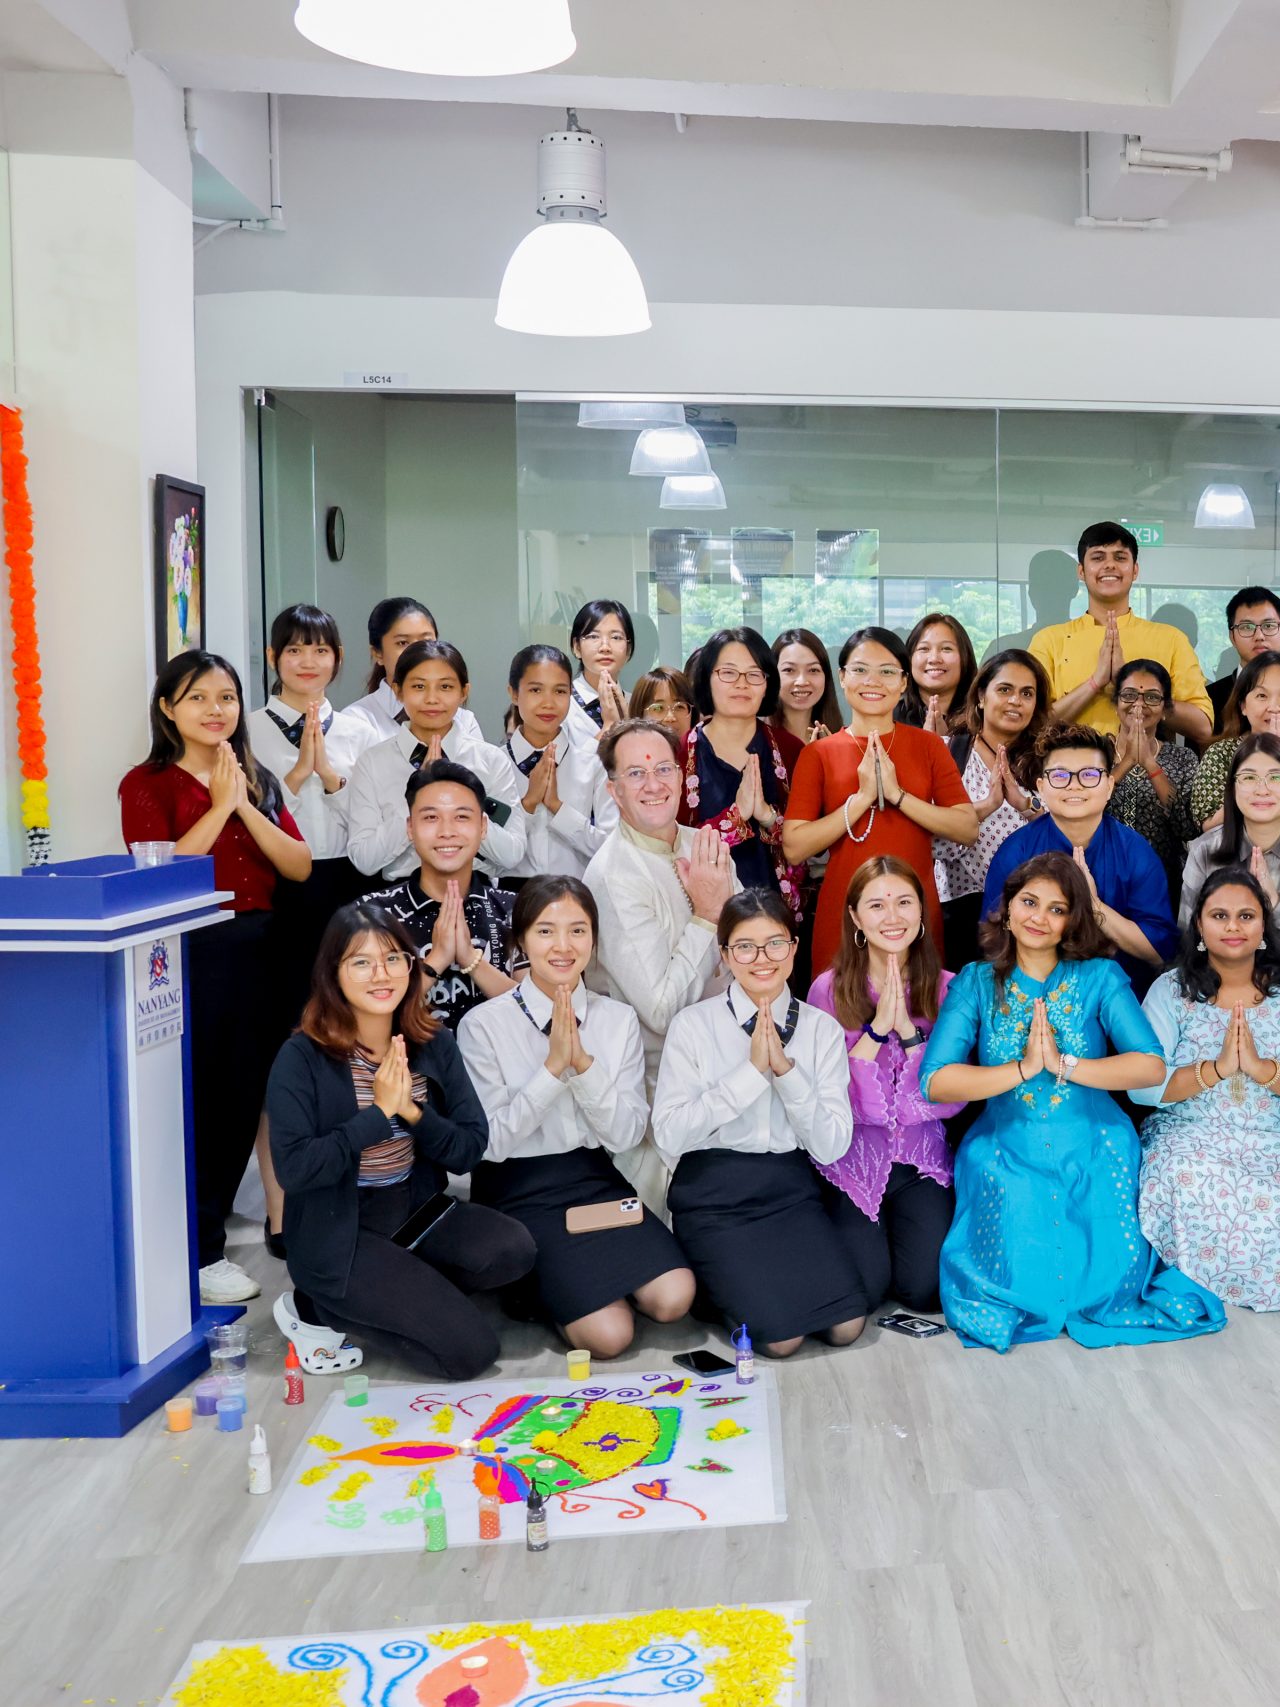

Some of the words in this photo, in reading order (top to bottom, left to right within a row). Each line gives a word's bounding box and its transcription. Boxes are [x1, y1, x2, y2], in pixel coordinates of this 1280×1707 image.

[362, 375, 392, 384] L5C14
[489, 923, 499, 950] YOUNG
[137, 988, 181, 1017] NANYANG
